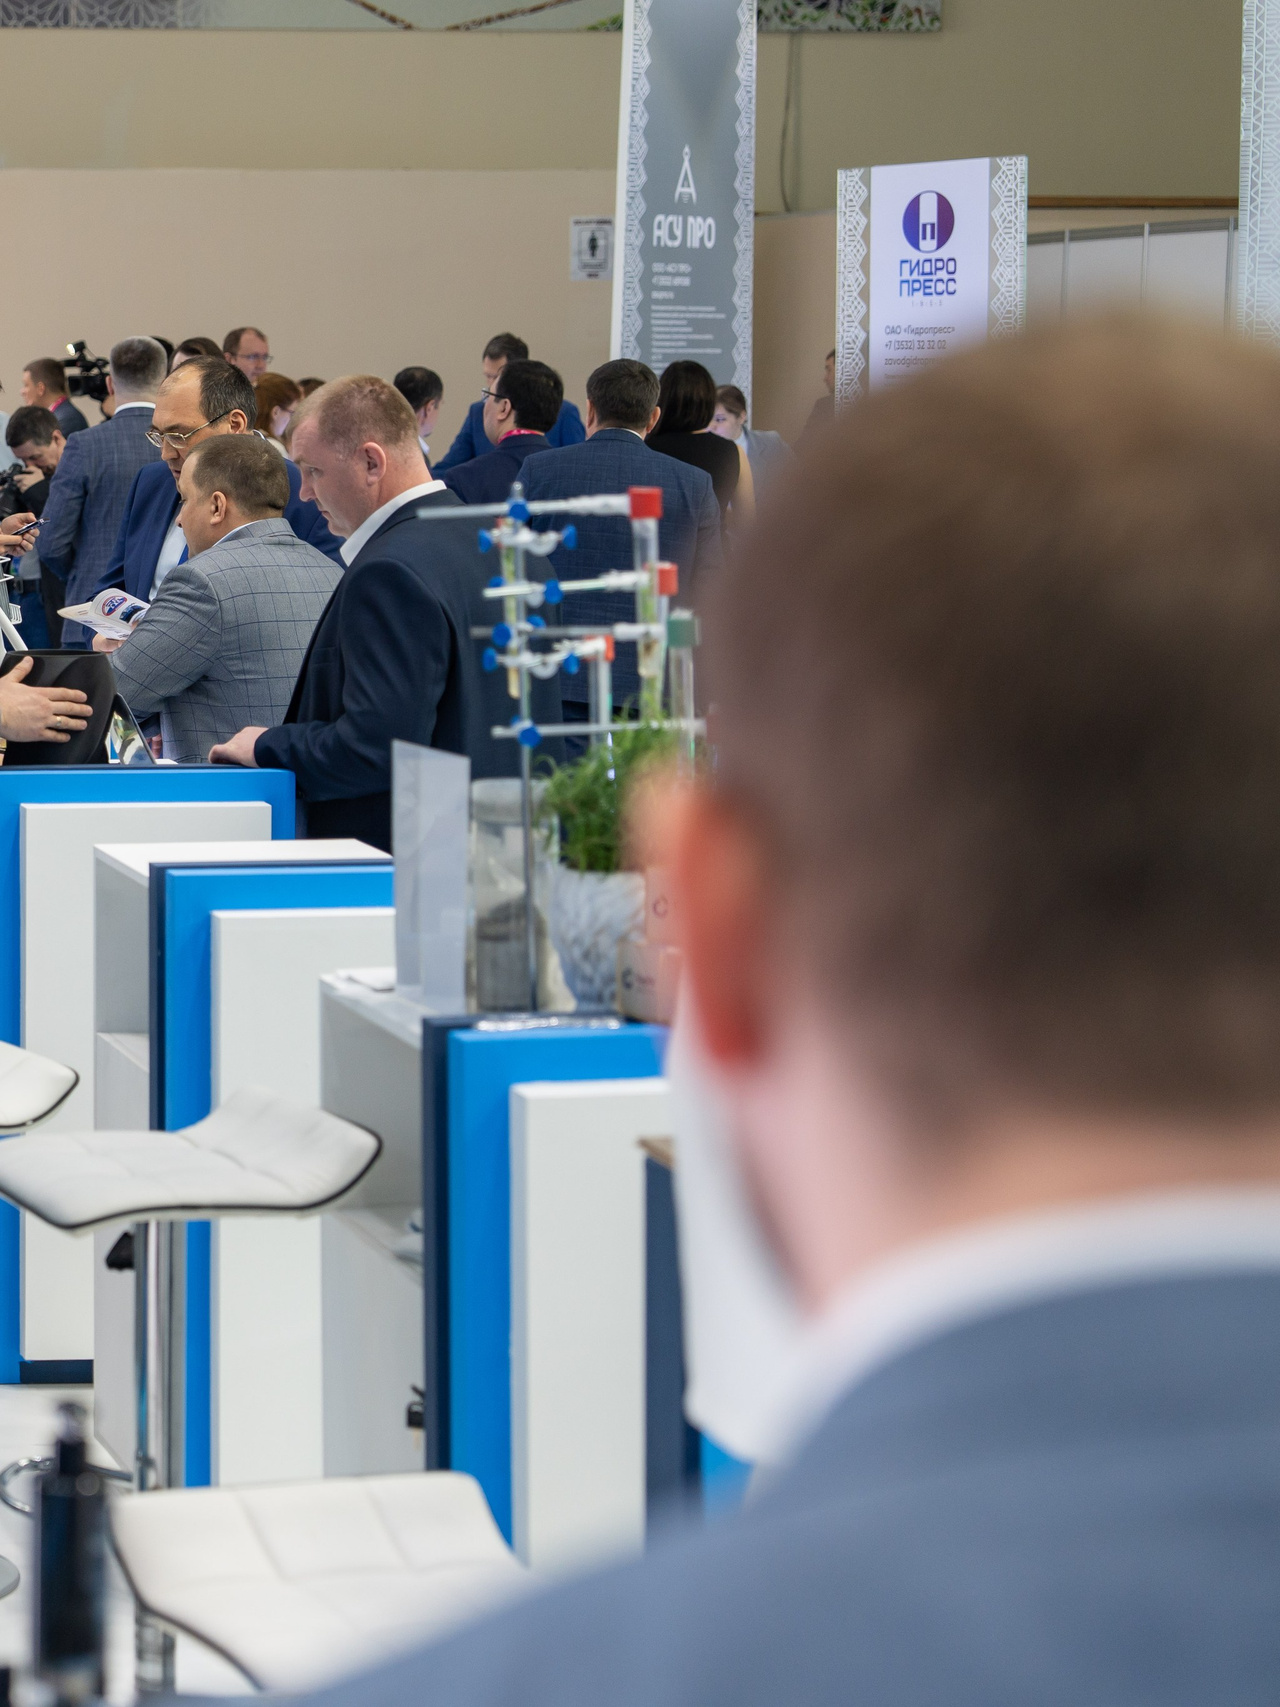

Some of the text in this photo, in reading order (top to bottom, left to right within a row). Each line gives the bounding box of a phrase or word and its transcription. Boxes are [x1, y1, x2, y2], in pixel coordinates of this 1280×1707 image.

[652, 213, 716, 249] АСУ ПРО
[899, 257, 957, 277] ГИДРО
[899, 278, 957, 297] ПРЕСС
[884, 325, 902, 335] ОАО
